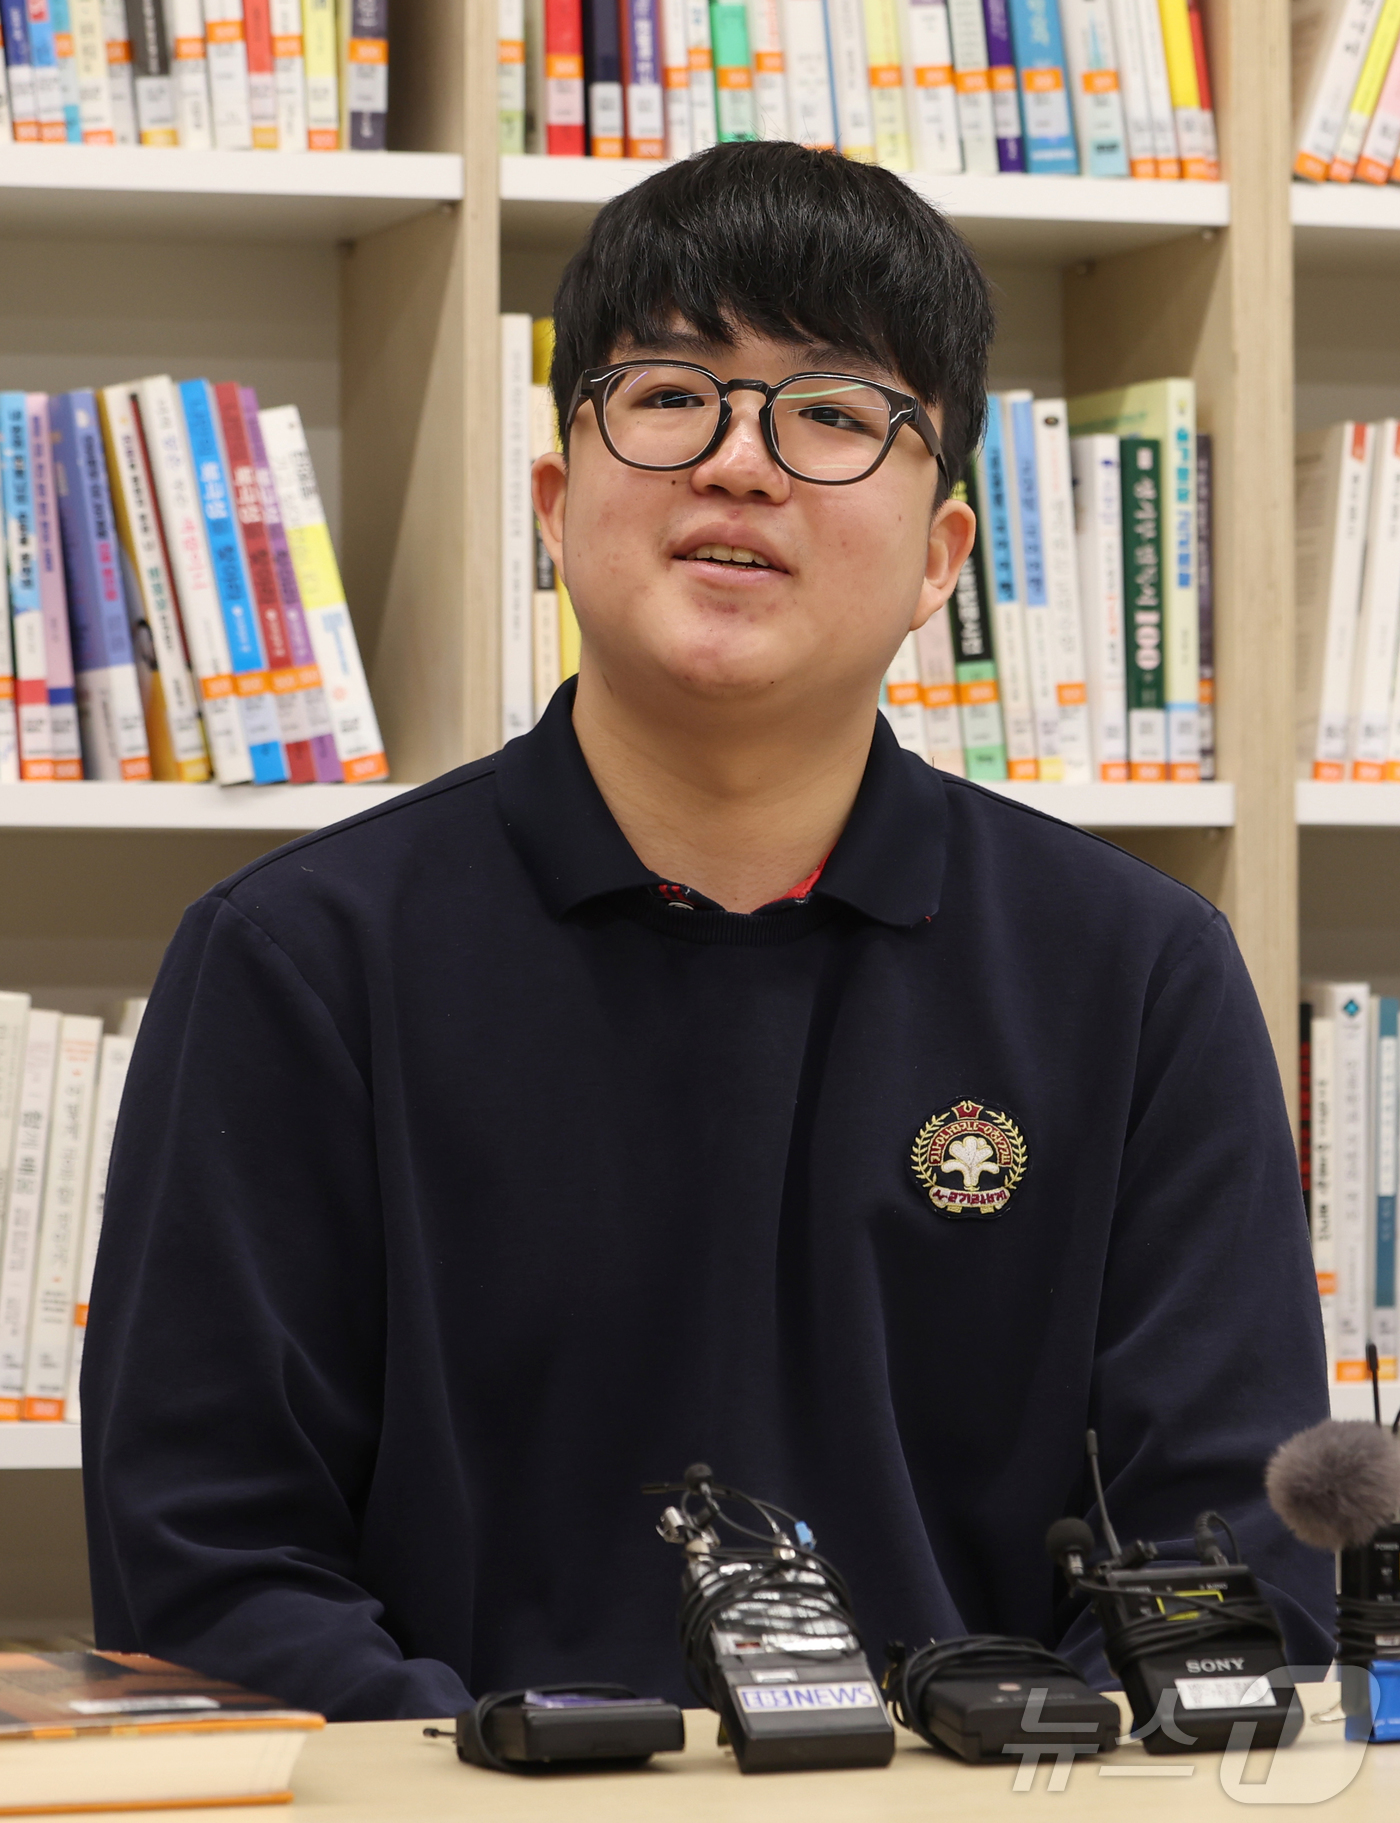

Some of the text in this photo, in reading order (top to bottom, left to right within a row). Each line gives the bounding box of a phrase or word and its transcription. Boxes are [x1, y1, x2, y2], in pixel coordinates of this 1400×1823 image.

[1134, 610, 1162, 670] 100
[1185, 1656, 1245, 1674] SONY
[795, 1686, 874, 1708] NEWS
